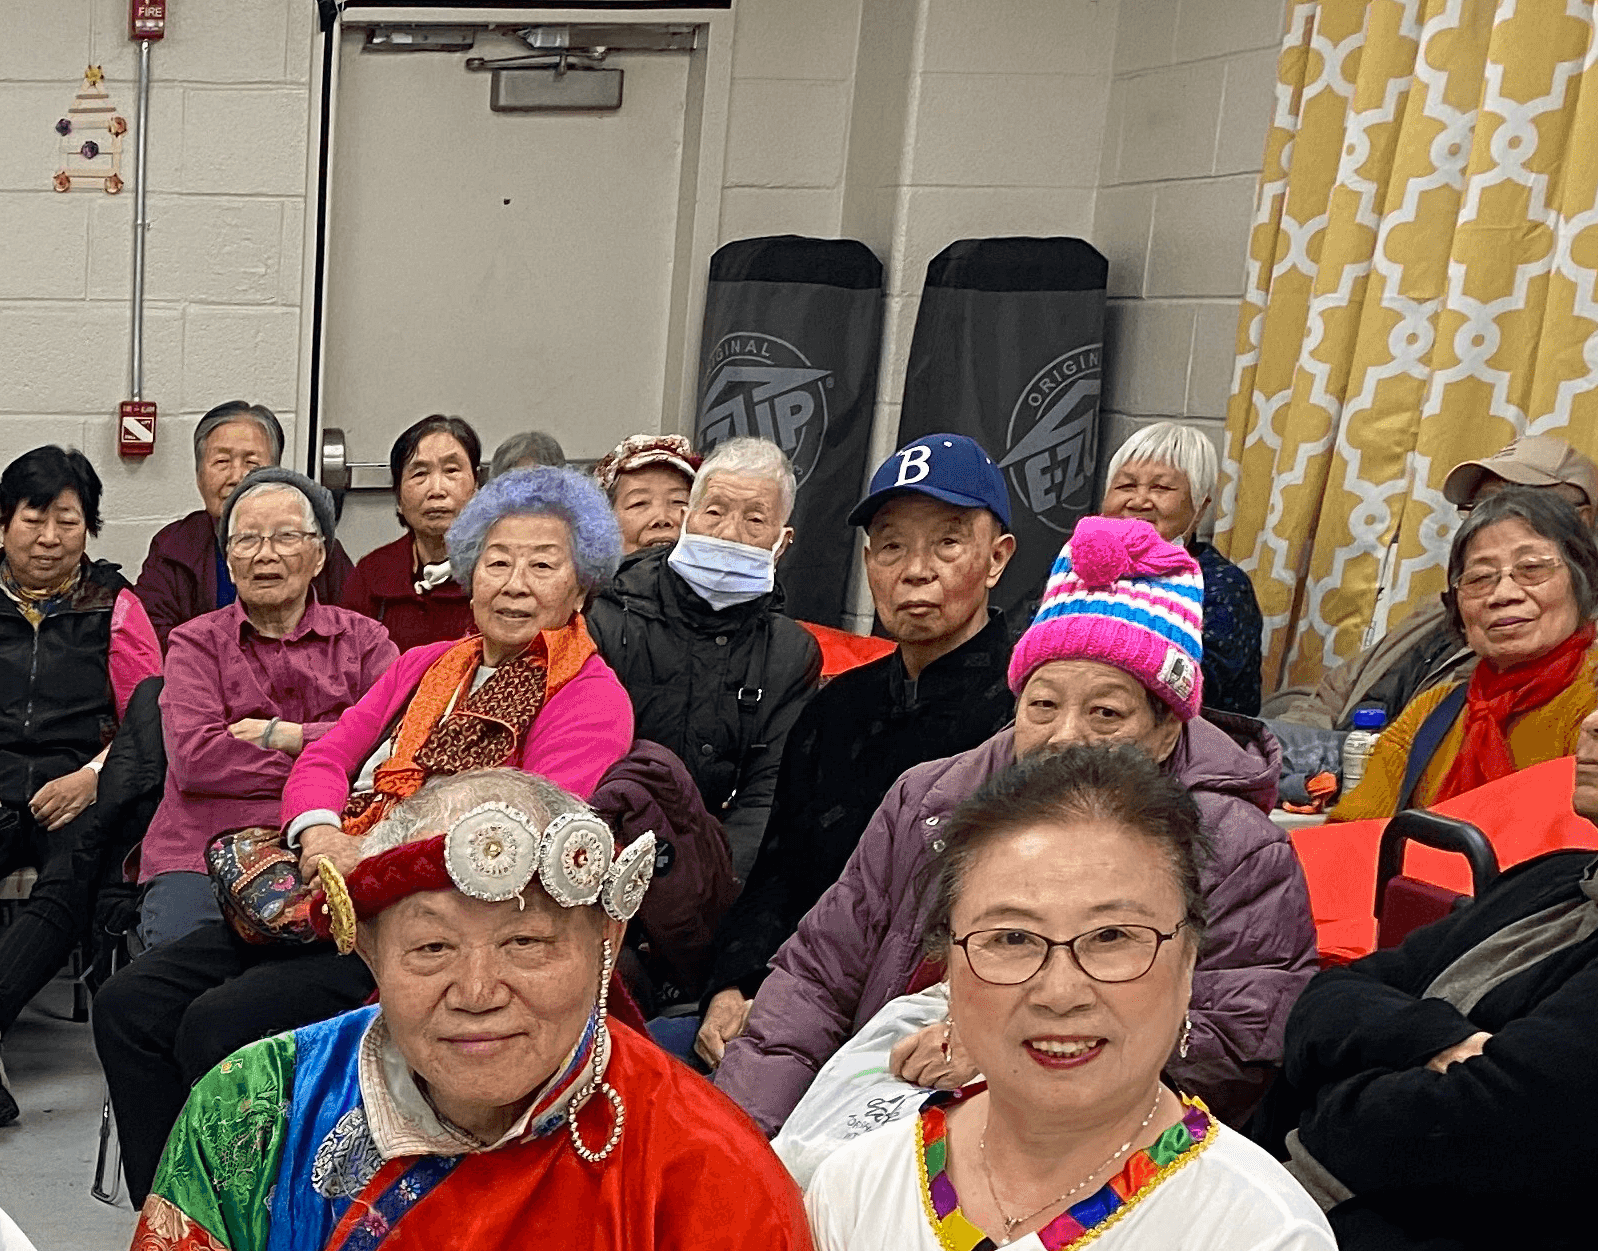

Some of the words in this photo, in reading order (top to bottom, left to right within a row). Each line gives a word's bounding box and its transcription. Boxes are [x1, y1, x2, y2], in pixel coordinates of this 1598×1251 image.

[138, 6, 162, 18] FIRE
[1027, 352, 1099, 407] ORIGIN
[893, 445, 932, 487] B
